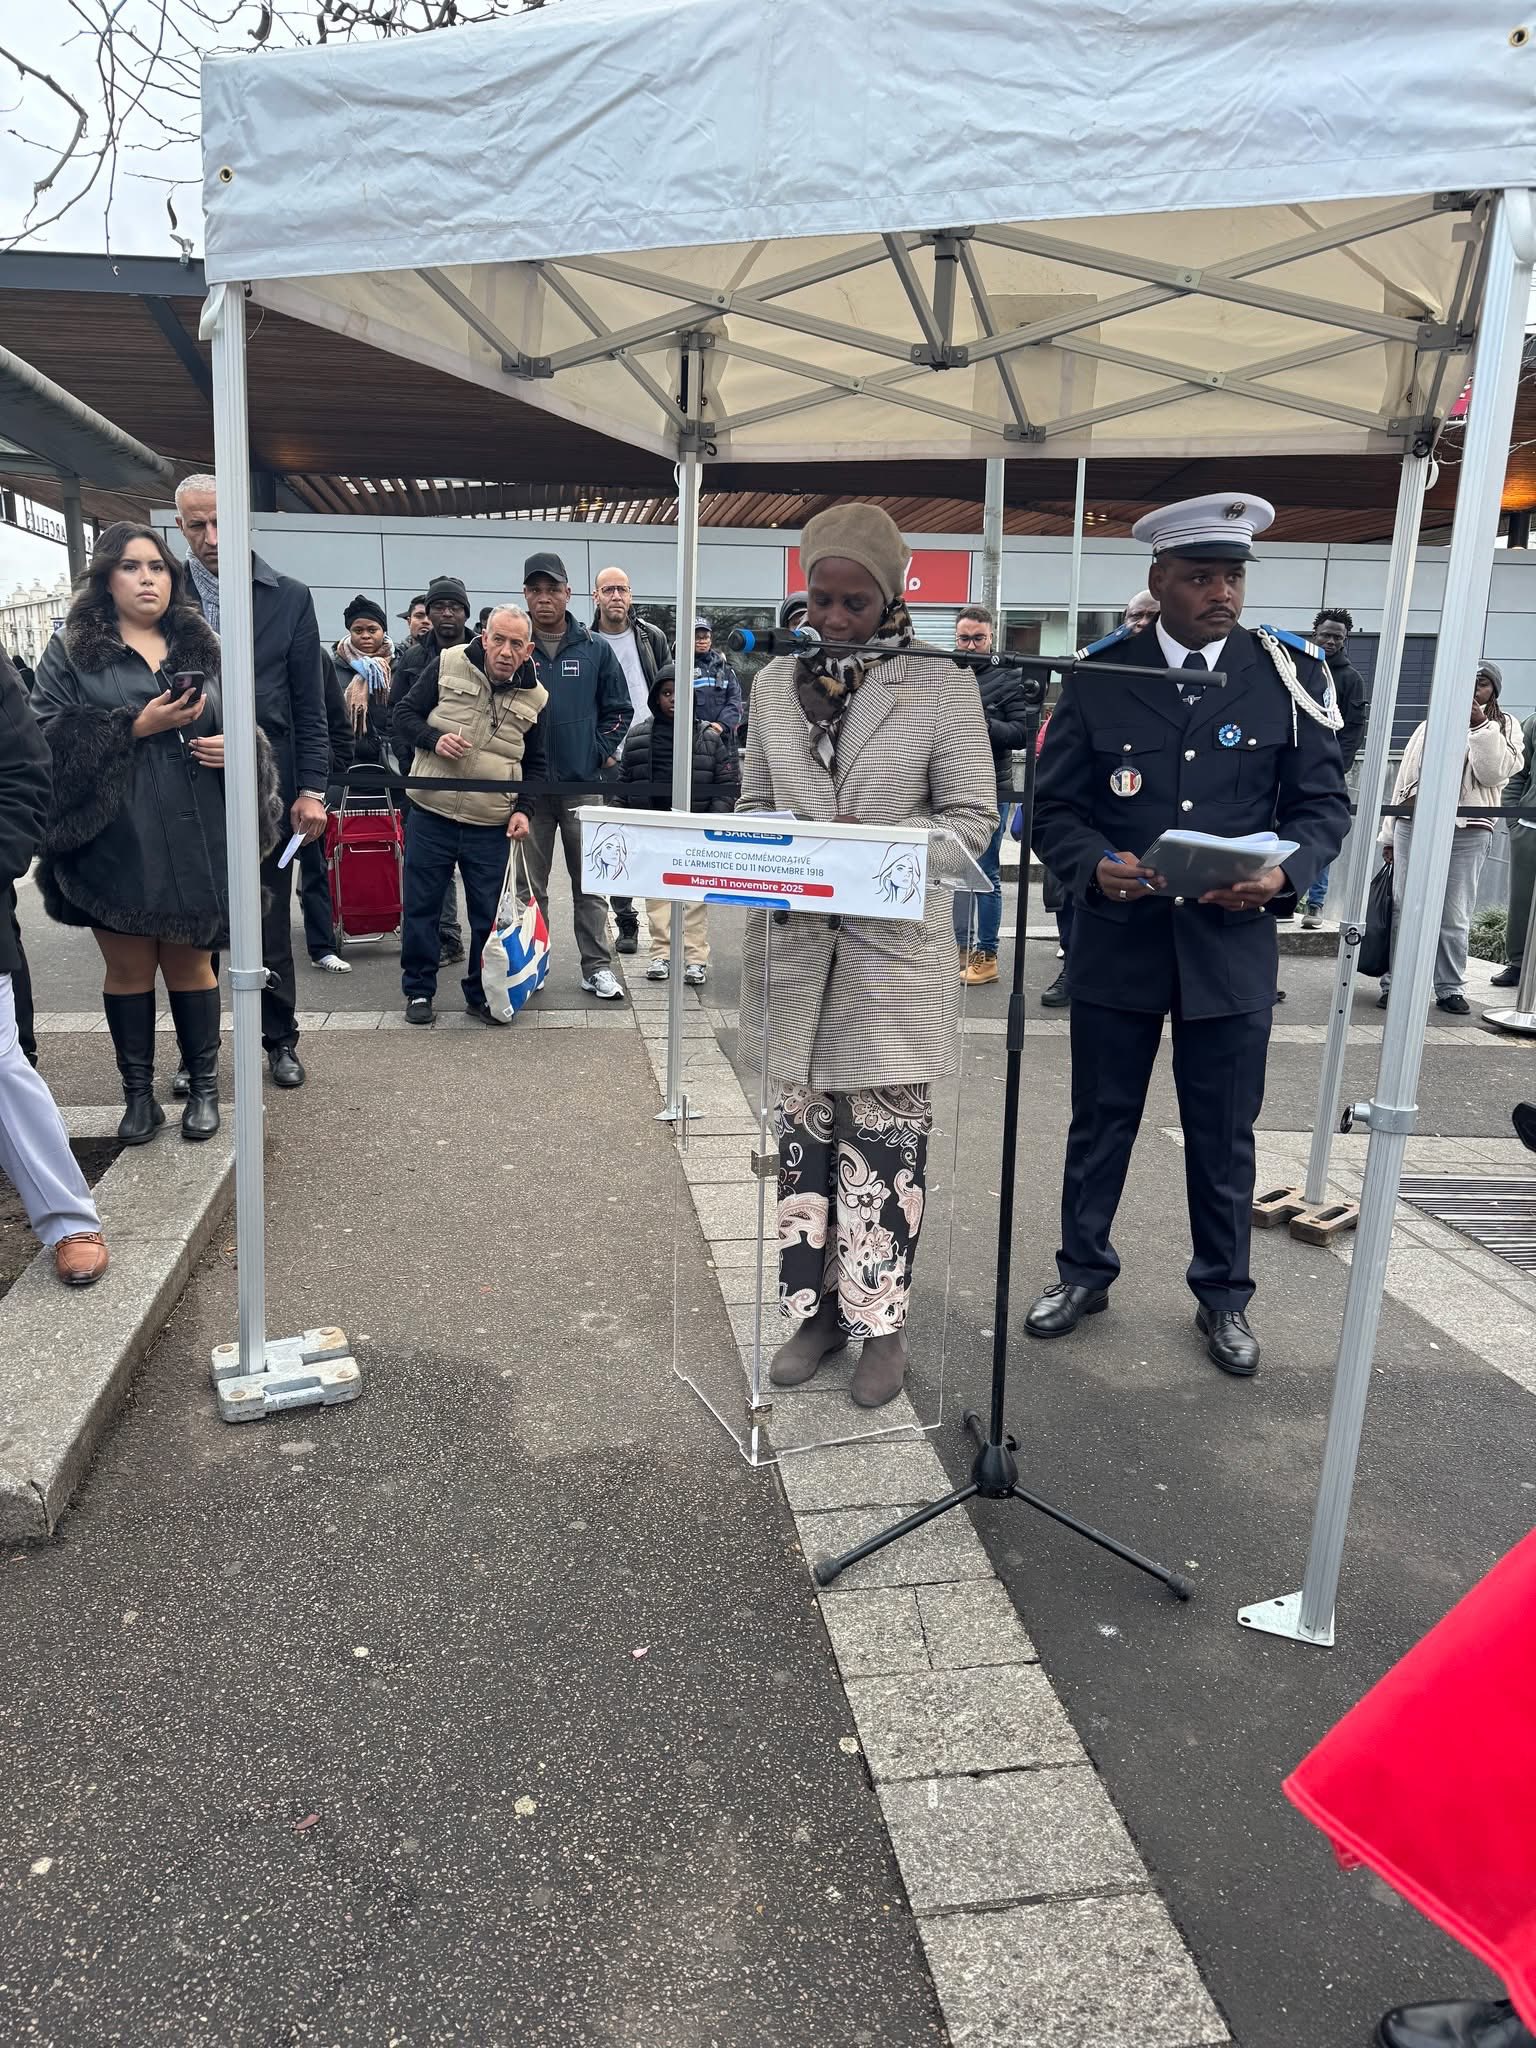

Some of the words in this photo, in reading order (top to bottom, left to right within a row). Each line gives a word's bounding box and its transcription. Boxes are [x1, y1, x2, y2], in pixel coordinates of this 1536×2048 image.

[685, 848, 733, 860] CÉRÉMONIE
[734, 852, 811, 865] COMMÉMORATIVE
[672, 858, 683, 867] DE
[735, 863, 748, 872] DU
[750, 863, 756, 872] 11
[758, 864, 805, 876] NOVEMBRE
[806, 867, 824, 877] 1918
[690, 876, 718, 887] Mardi
[719, 879, 727, 888] 11
[729, 880, 779, 891] novembre
[780, 883, 804, 893] 2025
